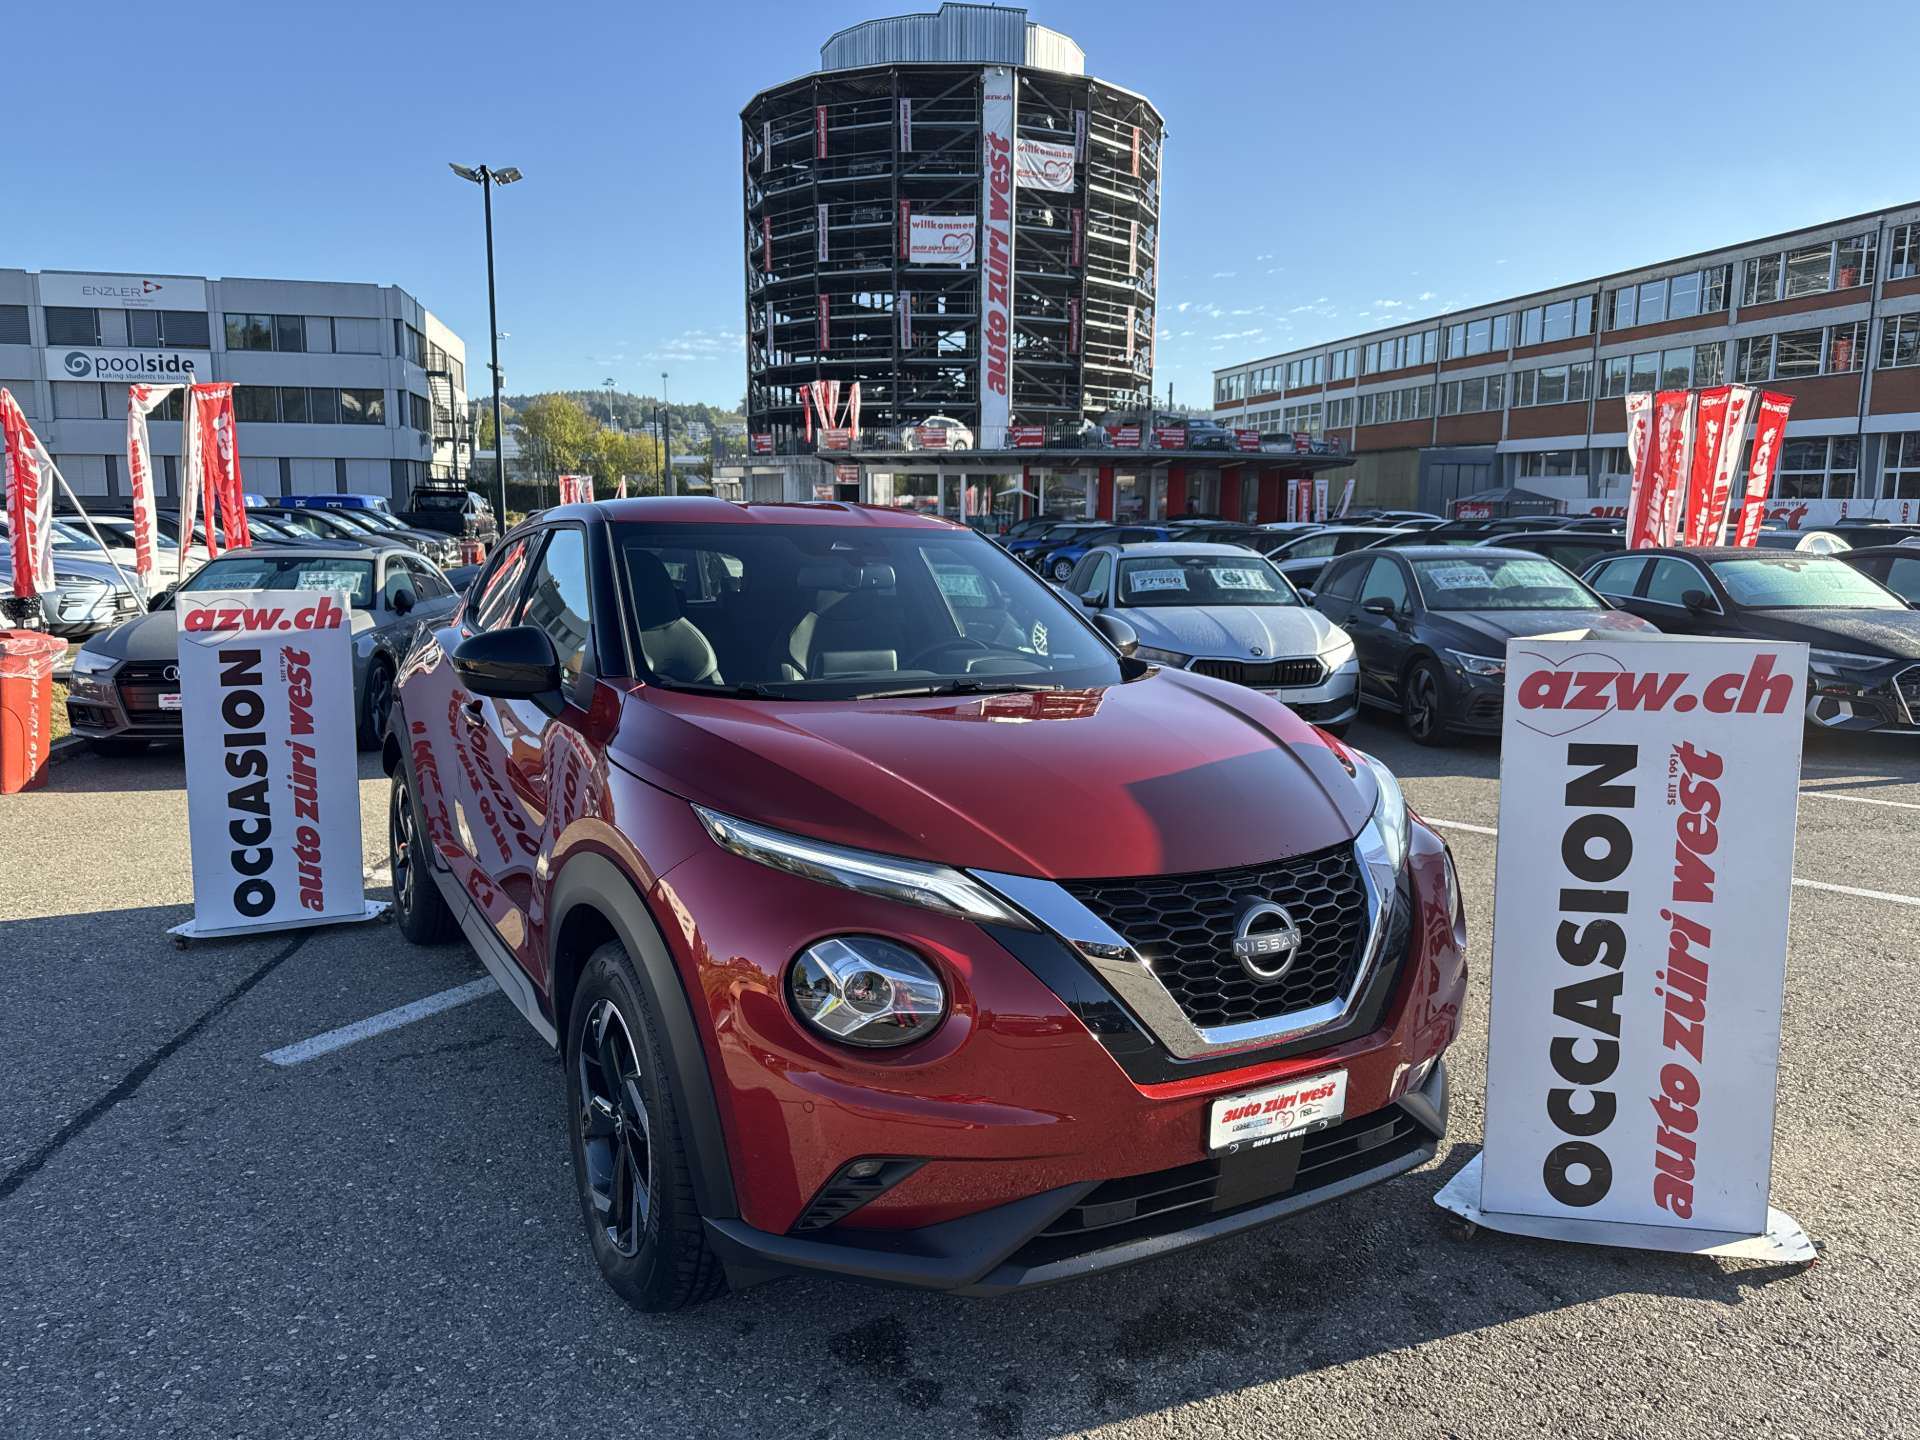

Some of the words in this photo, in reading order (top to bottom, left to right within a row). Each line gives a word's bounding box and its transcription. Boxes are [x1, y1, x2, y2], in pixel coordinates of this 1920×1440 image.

[988, 131, 1010, 220] west
[1017, 143, 1073, 158] willkommen
[912, 219, 975, 231] willkommen
[82, 286, 142, 297] ENZLER
[984, 224, 1009, 309] züri
[95, 353, 195, 378] poolside
[102, 372, 124, 381] taking
[126, 372, 156, 381] students
[167, 373, 190, 381] busine
[984, 310, 1007, 396] auto
[184, 597, 343, 633] azw.ch
[282, 645, 315, 736] west
[1517, 654, 1794, 714] azw.ch
[219, 649, 276, 918] OCCASION
[285, 739, 320, 824] züri
[1667, 781, 1677, 805] SEIT
[1669, 753, 1679, 779] 1991
[1673, 741, 1726, 904] west
[291, 824, 324, 913] auto
[1235, 935, 1300, 953] NISSAN
[1543, 742, 1639, 1207] OCCASION
[1654, 909, 1712, 1064] züri
[1222, 1102, 1262, 1124] auto
[1263, 1091, 1298, 1114] züri
[1300, 1082, 1337, 1105] west
[1252, 1137, 1271, 1148] auto
[1290, 1128, 1307, 1137] west
[1648, 1064, 1701, 1221] auto
